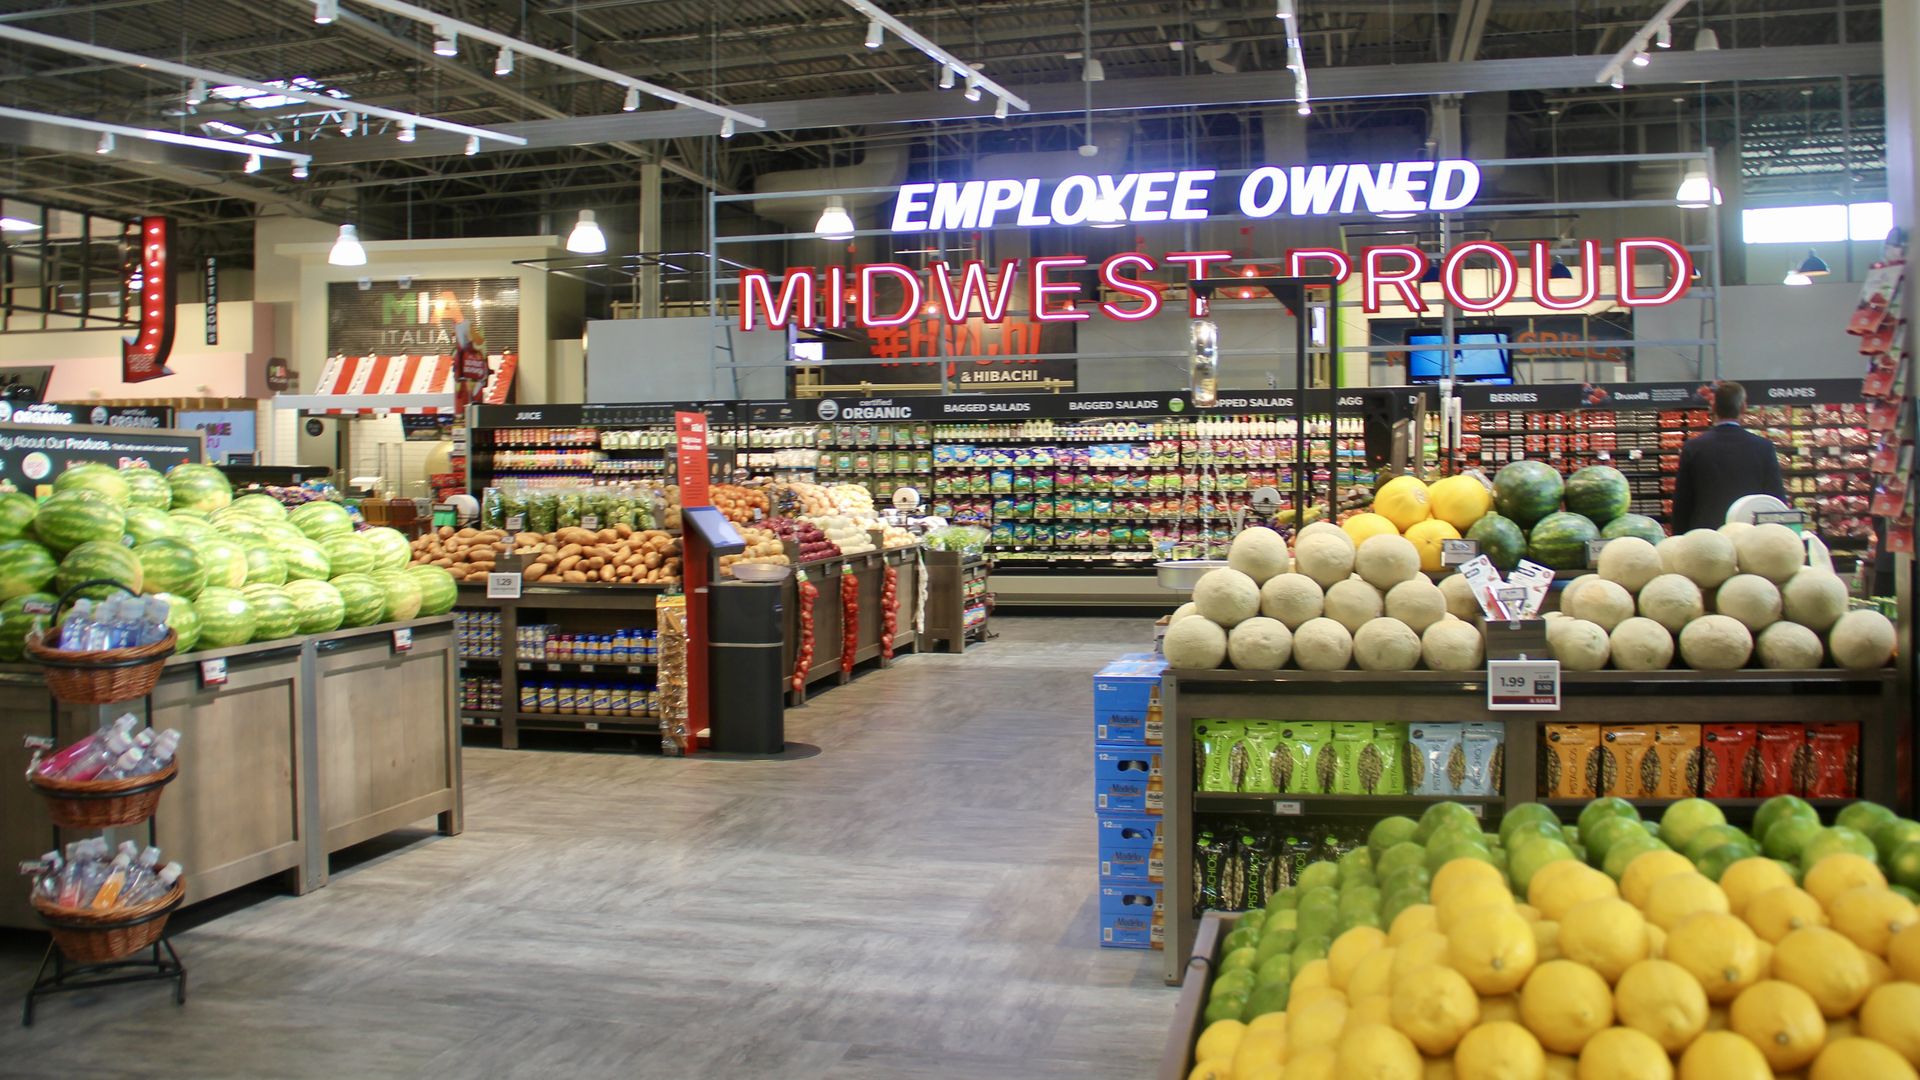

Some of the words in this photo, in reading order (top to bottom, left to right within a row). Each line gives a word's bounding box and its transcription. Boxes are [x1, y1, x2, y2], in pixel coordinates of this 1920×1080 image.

[891, 170, 1215, 232] EMPLOYEE
[1239, 159, 1481, 218] OWNED
[739, 250, 1232, 332] MIDWEST
[1285, 237, 1694, 315] PROUD
[206, 256, 217, 343] RESTROOMS
[382, 288, 465, 325] MIA
[380, 329, 457, 344] ITALIA
[961, 371, 972, 382] &
[974, 370, 1038, 382] HIBACHI
[1489, 393, 1538, 403] BERRIES
[1768, 386, 1816, 398] GRAPES
[859, 399, 893, 407] certified
[944, 403, 987, 412] BAGGED
[988, 402, 1031, 412] SALADS
[1069, 401, 1114, 411] BAGGED
[1115, 400, 1159, 410] SALADS
[1215, 398, 1248, 408] OPPED
[1249, 398, 1294, 408] SALADS
[13, 410, 73, 424] ORGANIC
[515, 411, 542, 420] JUICE
[842, 406, 912, 420] ORGANIC
[109, 415, 160, 428] ORGANIC
[46, 437, 66, 449] Our
[496, 578, 512, 586] 1.29
[1500, 676, 1525, 687] 1.99
